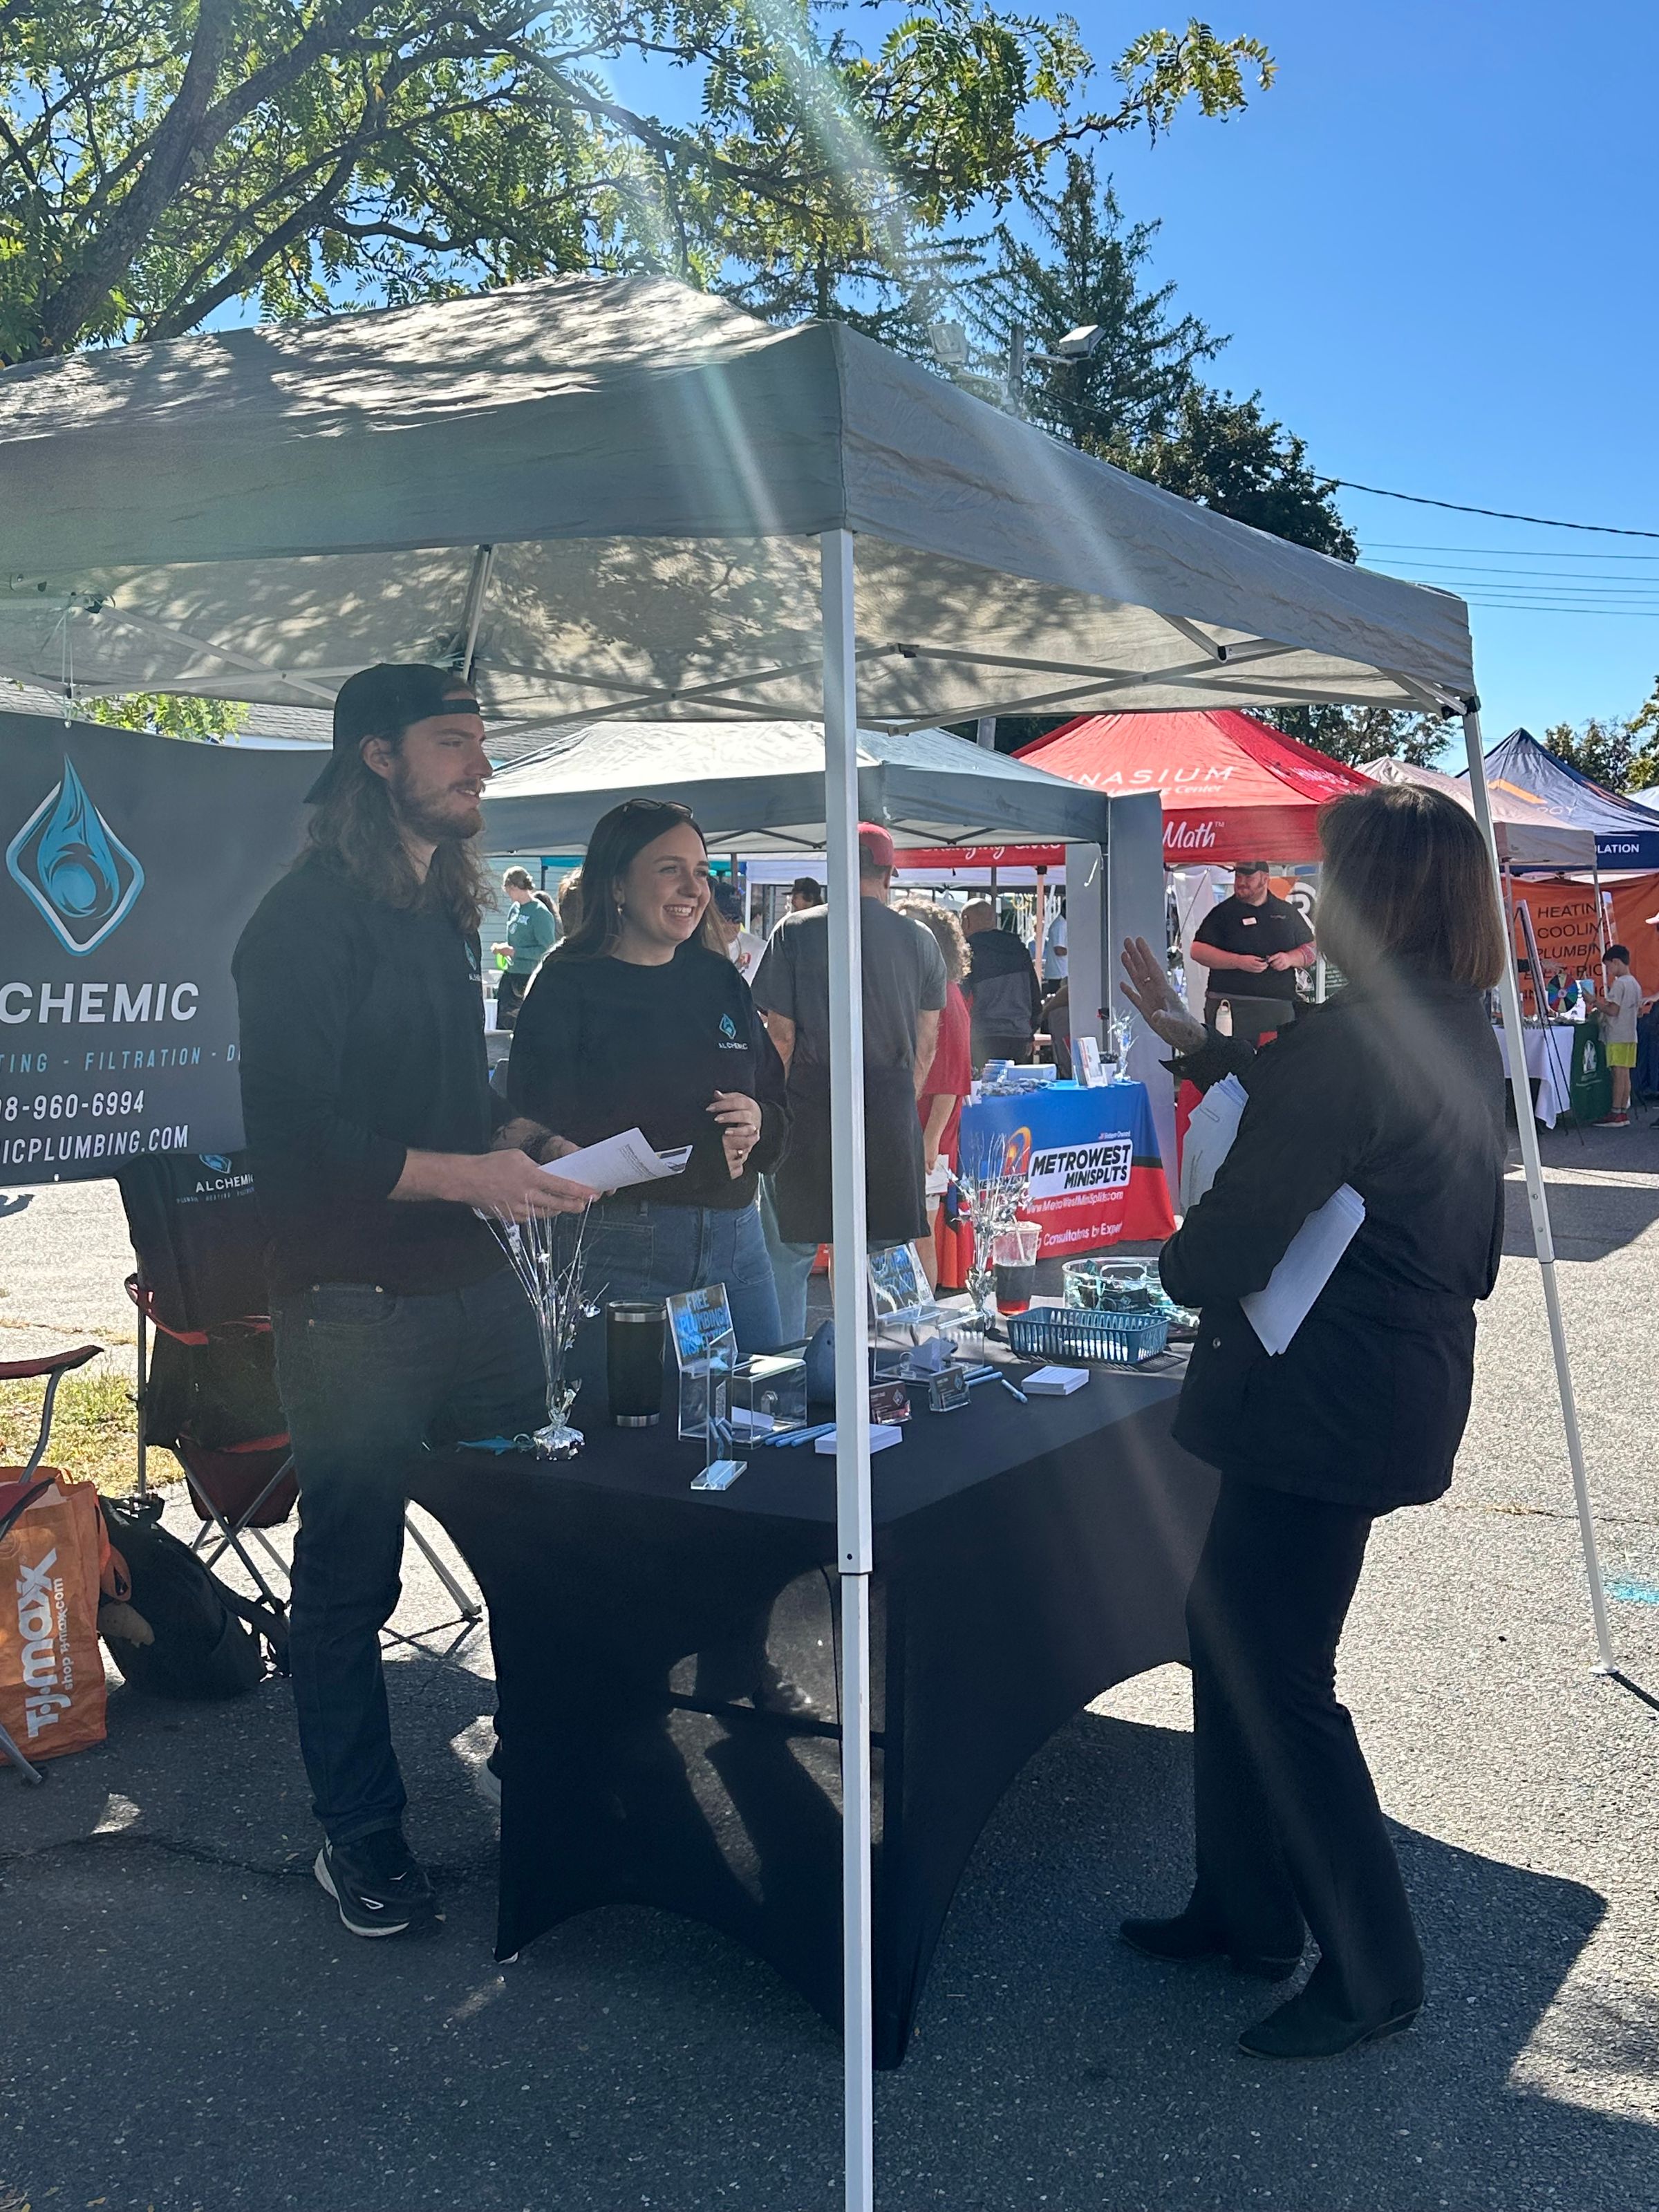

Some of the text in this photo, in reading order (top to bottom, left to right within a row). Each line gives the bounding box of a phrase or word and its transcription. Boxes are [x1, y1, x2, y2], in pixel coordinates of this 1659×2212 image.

[1174, 785, 1224, 794] Center
[1538, 903, 1597, 919] HEATIN
[1537, 941, 1608, 959] PLUMBIN
[0, 982, 199, 1024] CHEMIC
[85, 1047, 201, 1071] FILTRATION
[3, 1125, 189, 1164] ICPLUMBING.COM
[1031, 1144, 1131, 1177] METROWEST
[1064, 1165, 1127, 1189] MINISPLITS
[685, 1289, 710, 1312] FREE
[679, 1306, 725, 1333] PLUMBING
[62, 1656, 74, 1691] shop
